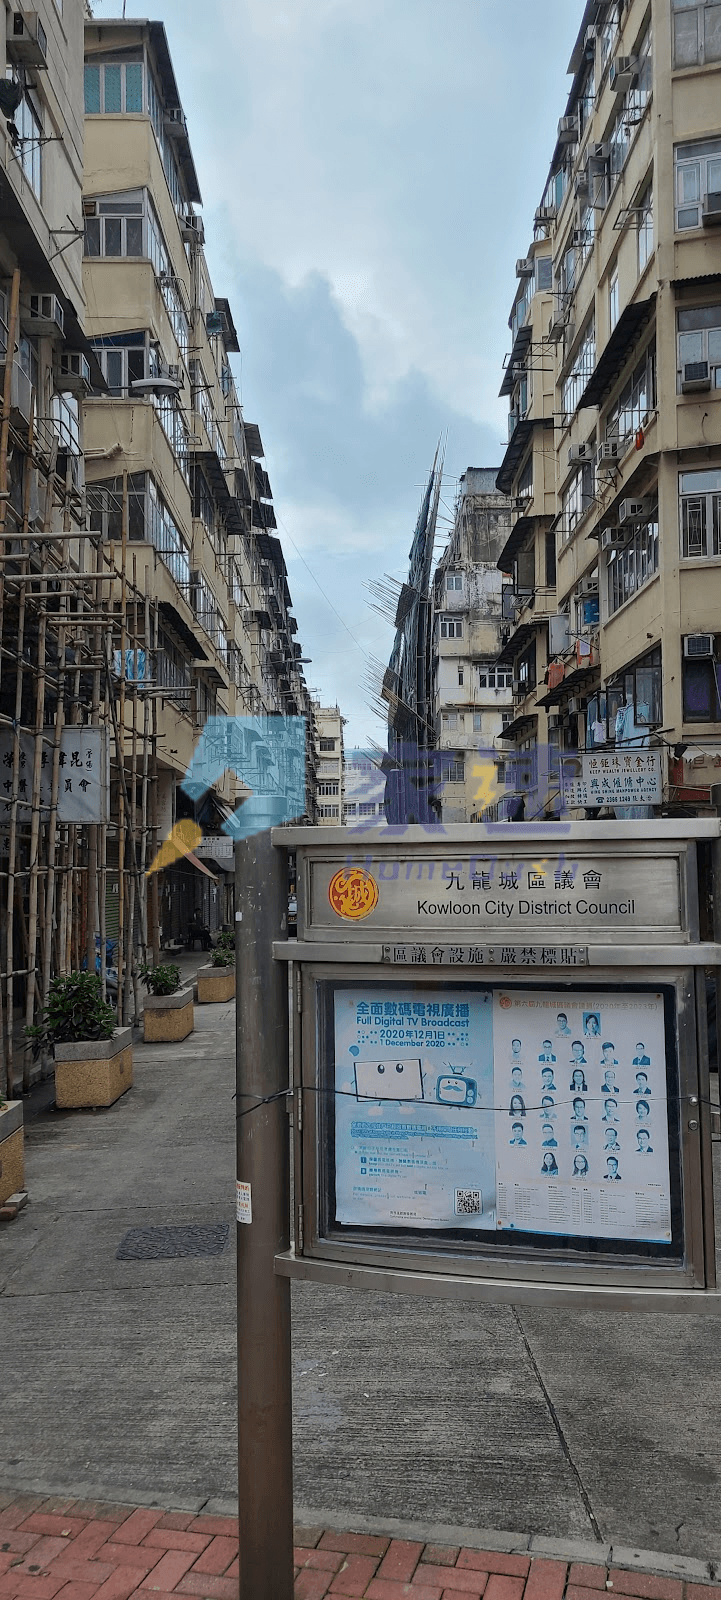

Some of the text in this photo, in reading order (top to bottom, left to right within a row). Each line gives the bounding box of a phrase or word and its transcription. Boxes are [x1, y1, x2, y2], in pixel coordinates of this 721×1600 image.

[588, 755, 656, 769] 恒鉅珠寶金行
[445, 870, 603, 891] 九龍城區議會
[417, 900, 635, 918] Kowloon City District Council
[393, 947, 577, 964] 區議會設施 嚴禁標貼
[356, 1001, 469, 1017] 全面數碼電視廣播
[356, 1016, 469, 1027] Full Digital TV Broadcast
[379, 1030, 445, 1039] 2020年12月1日
